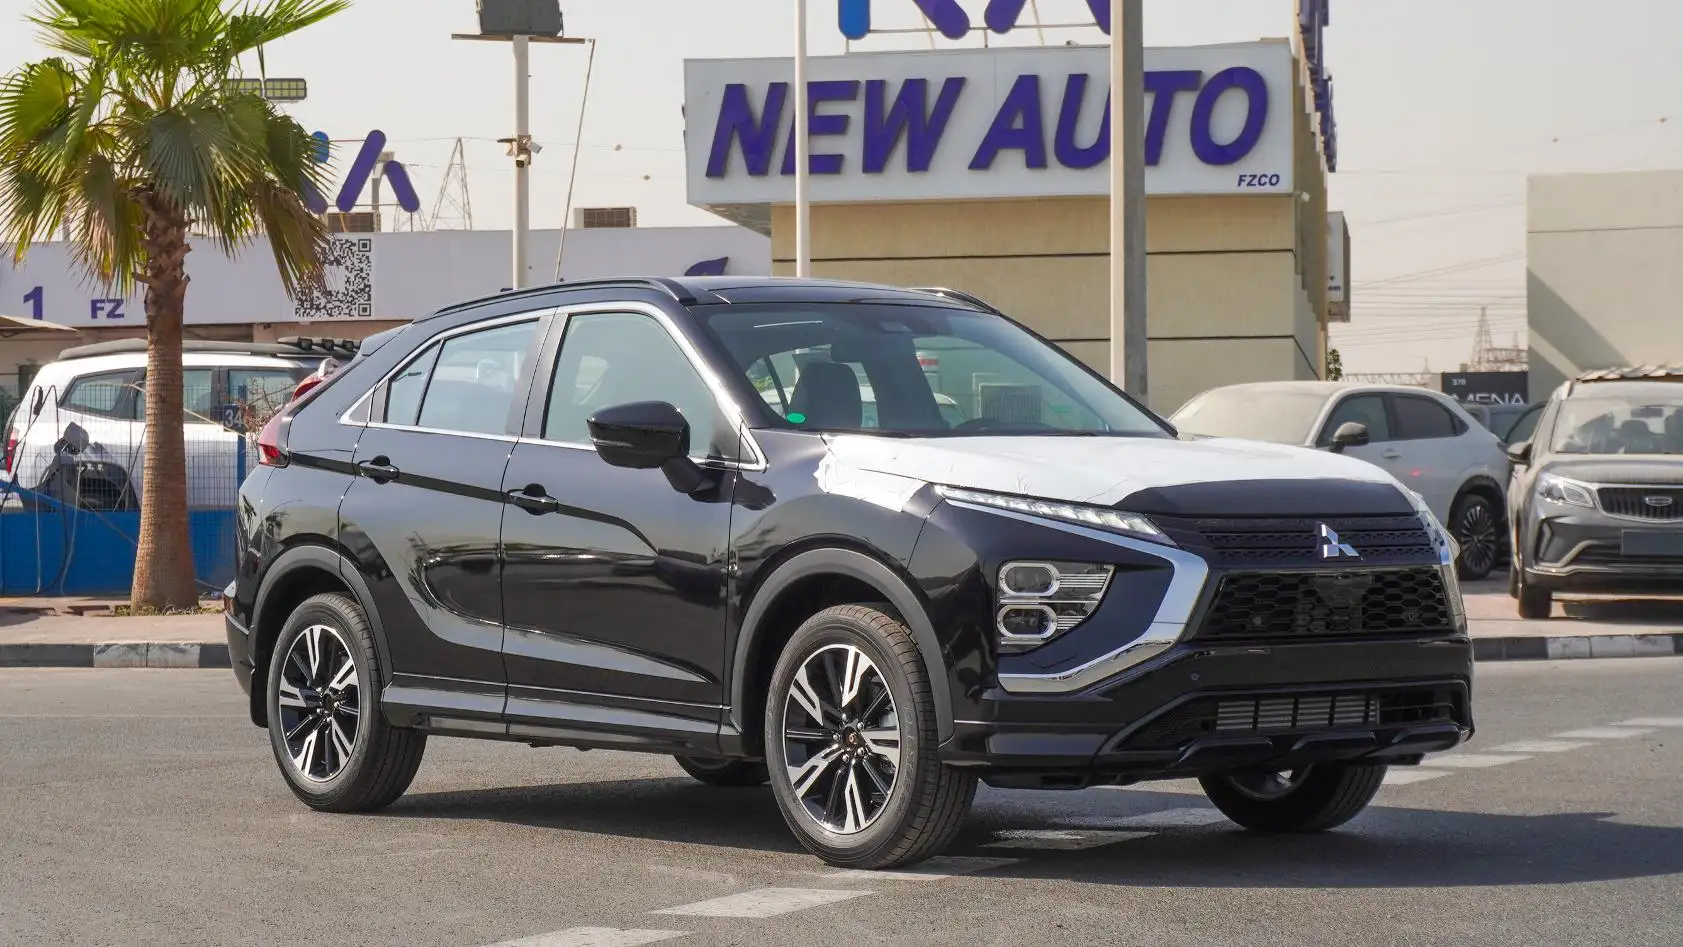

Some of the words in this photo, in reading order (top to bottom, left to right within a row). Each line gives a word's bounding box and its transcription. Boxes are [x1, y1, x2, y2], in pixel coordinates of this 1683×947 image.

[705, 77, 967, 178] NEW
[967, 66, 1269, 170] AUTO
[1237, 173, 1280, 187] FZCO
[23, 286, 43, 321] 1
